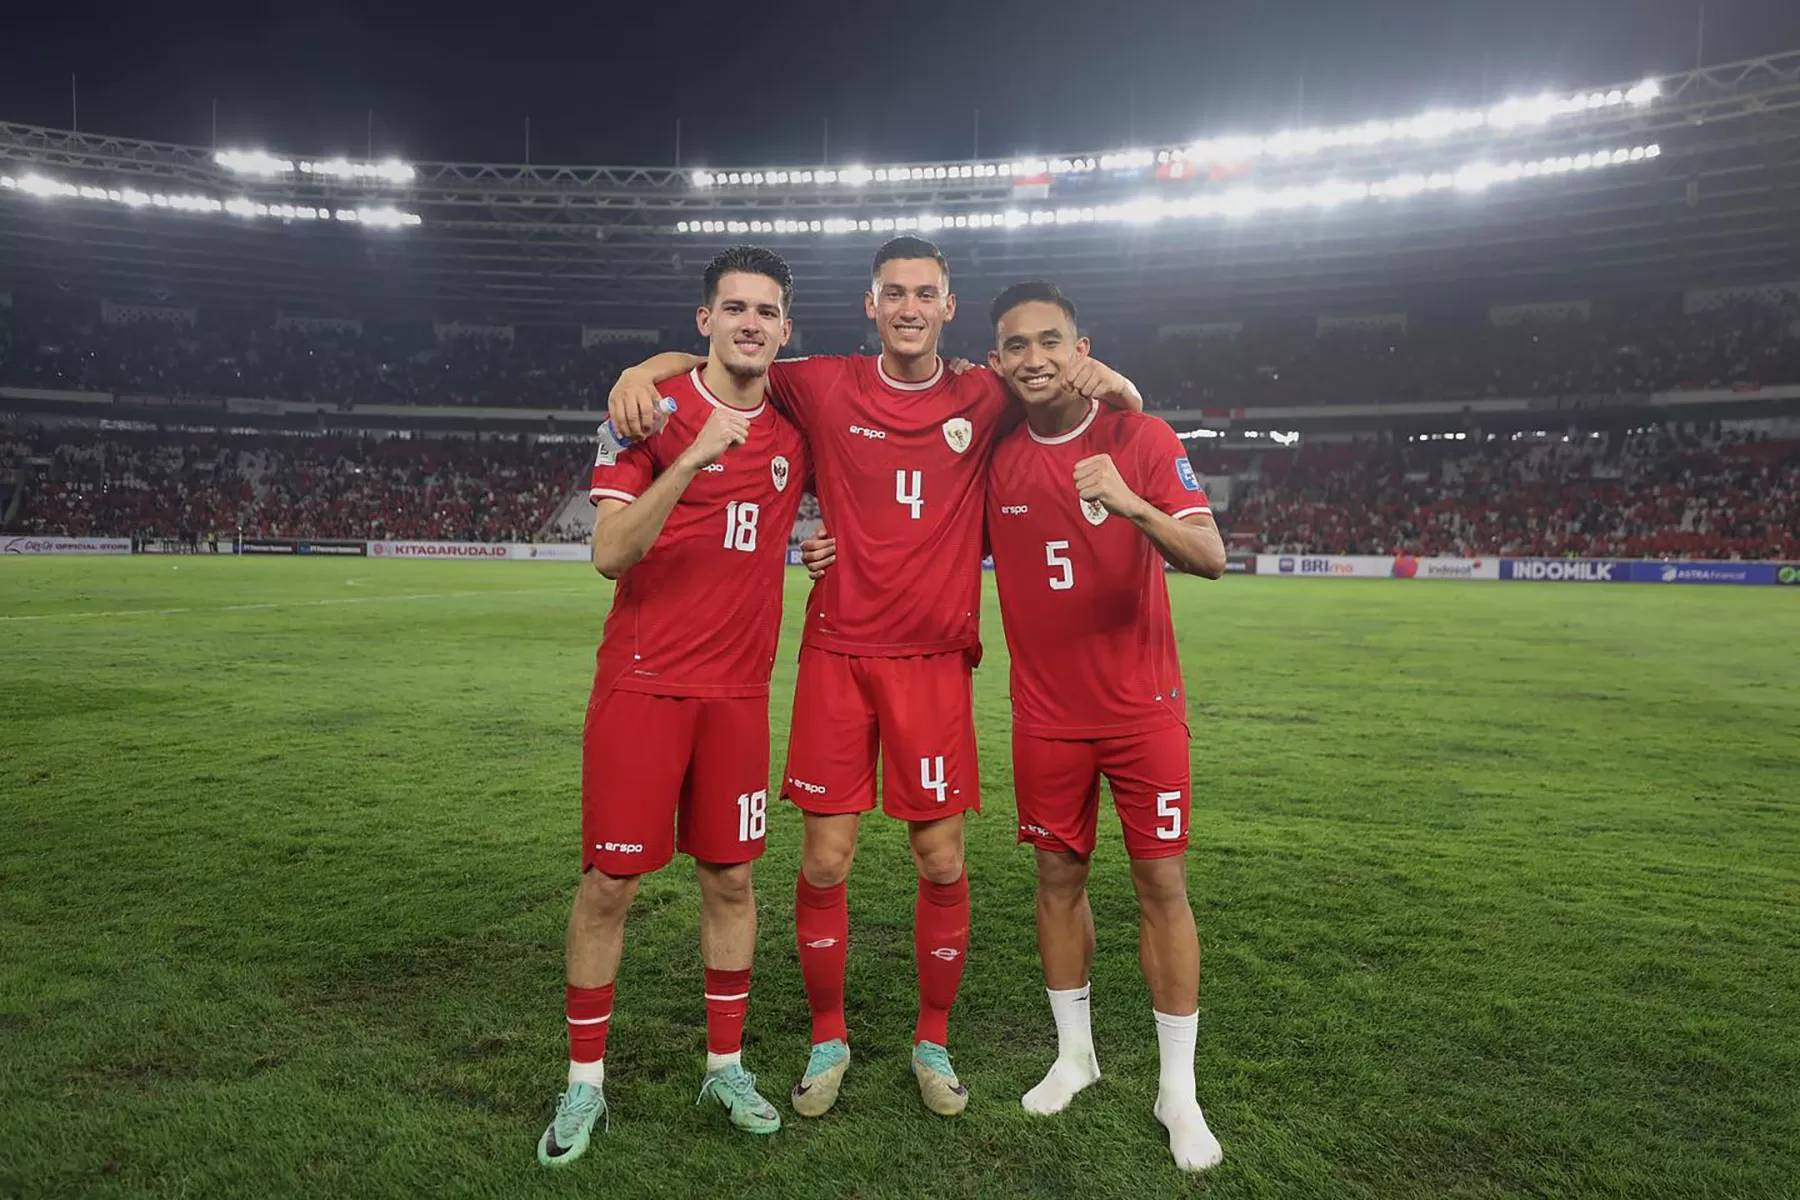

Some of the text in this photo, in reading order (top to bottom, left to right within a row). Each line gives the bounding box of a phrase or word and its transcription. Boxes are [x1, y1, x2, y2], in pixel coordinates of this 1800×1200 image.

[849, 425, 886, 439] erspo
[896, 469, 924, 519] 4
[723, 501, 760, 552] 18
[1045, 540, 1074, 590] 5
[1512, 561, 1612, 580] INDOMILK
[794, 779, 826, 794] erspo
[920, 756, 948, 802] 4
[737, 789, 767, 841] 18
[1156, 790, 1181, 840] 5
[604, 842, 643, 854] erspo
